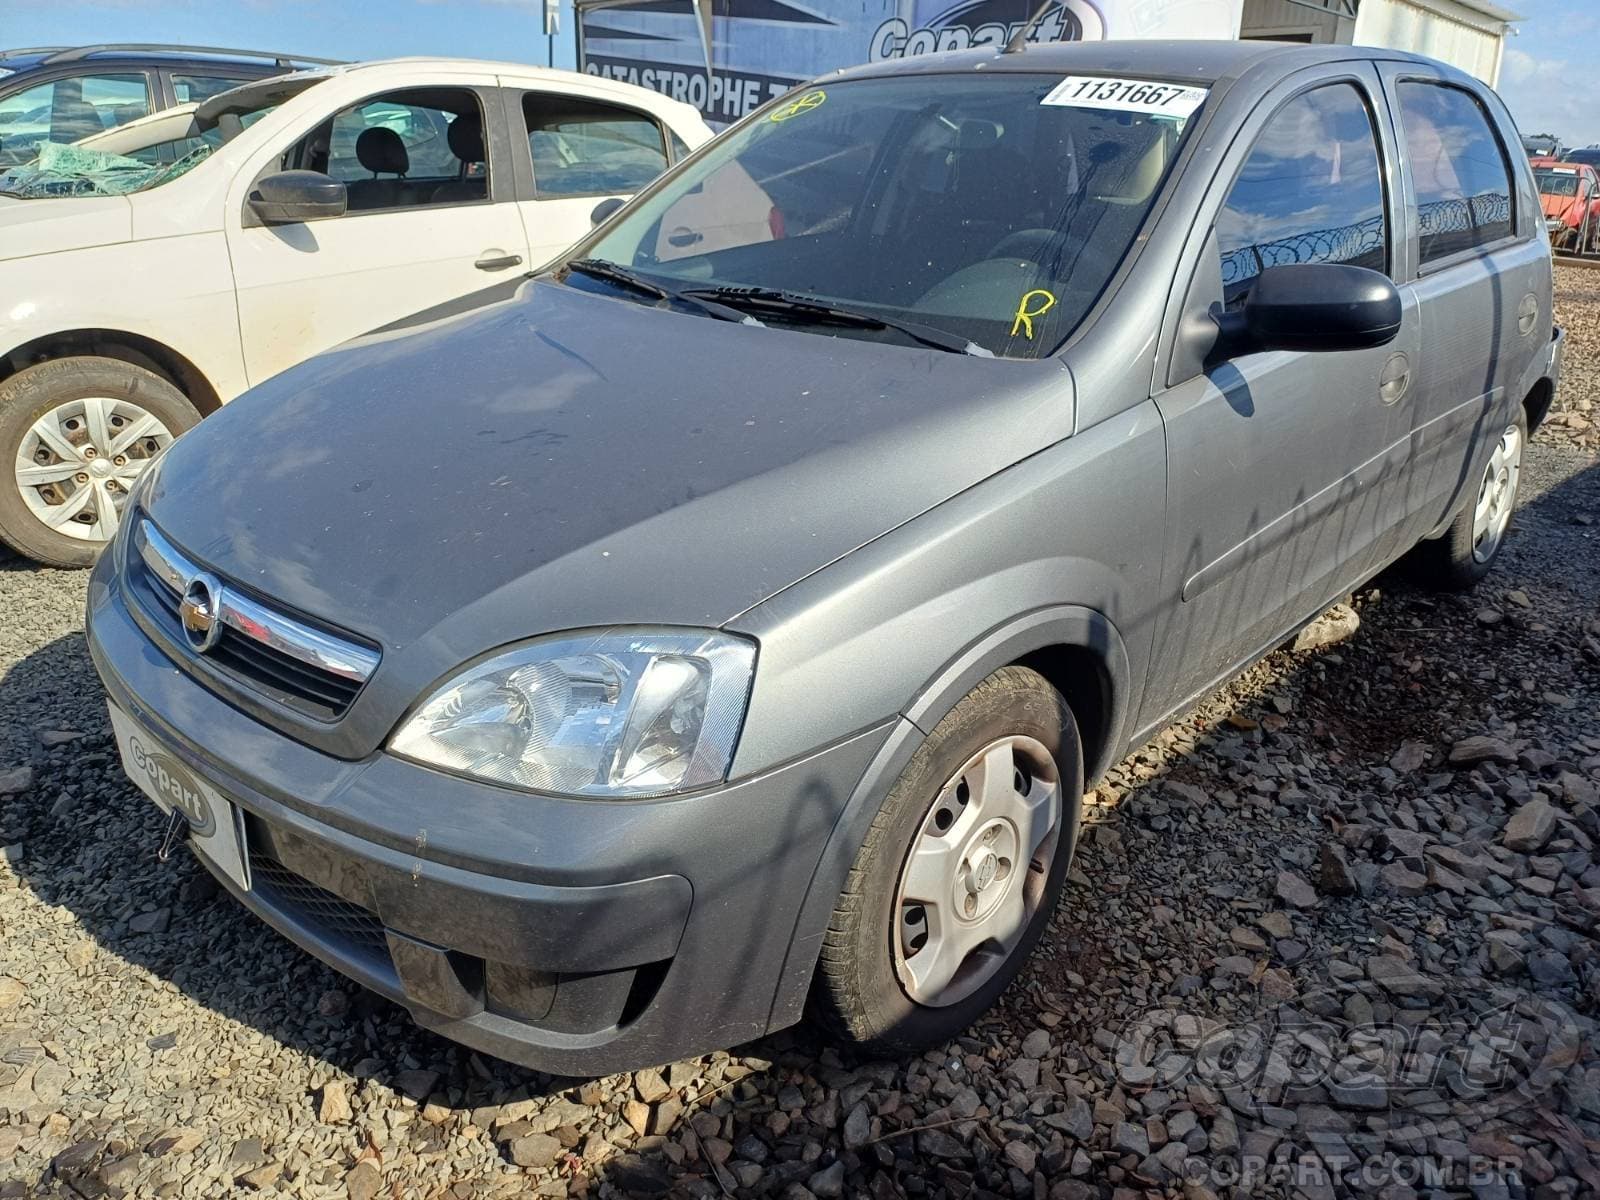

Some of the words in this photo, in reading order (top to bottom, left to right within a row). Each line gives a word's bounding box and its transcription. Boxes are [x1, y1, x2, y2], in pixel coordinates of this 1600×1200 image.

[1072, 80, 1186, 106] 1131667
[1010, 289, 1056, 340] R
[129, 735, 203, 822] Copart
